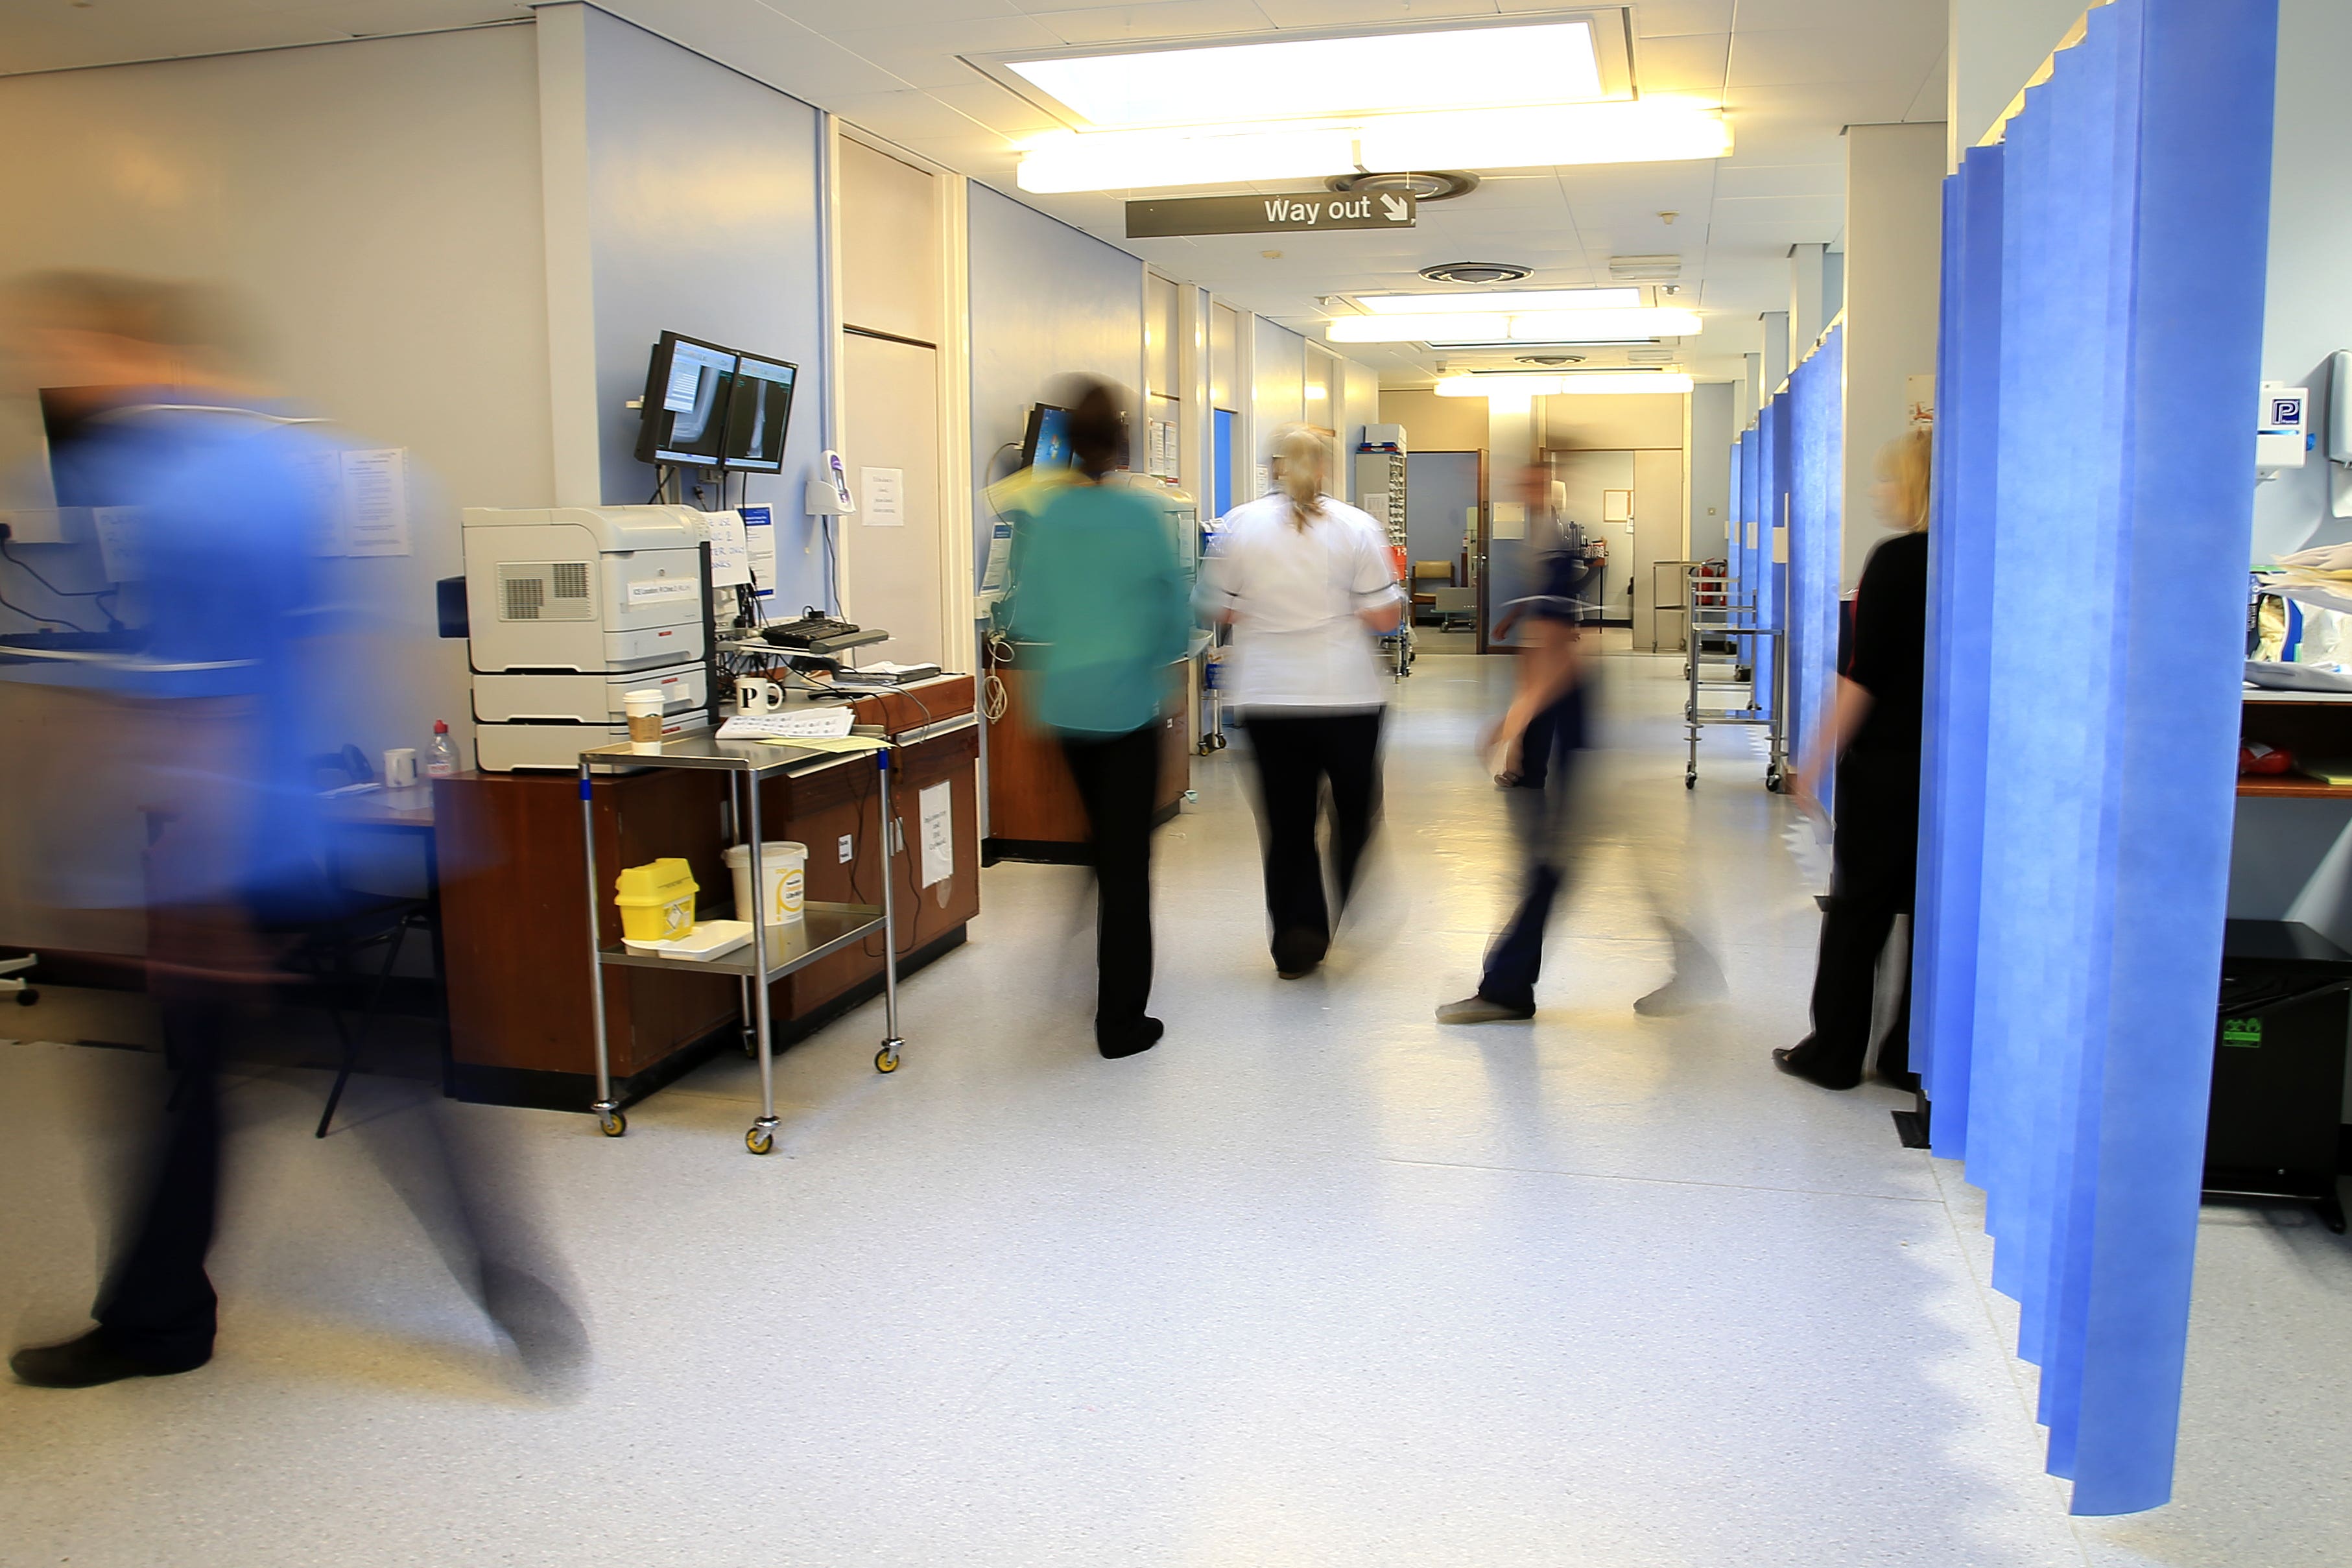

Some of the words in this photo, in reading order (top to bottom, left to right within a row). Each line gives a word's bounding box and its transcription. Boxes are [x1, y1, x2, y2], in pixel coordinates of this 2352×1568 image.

[1265, 200, 1320, 225] Way
[1329, 196, 1372, 219] out
[741, 687, 757, 708] P
